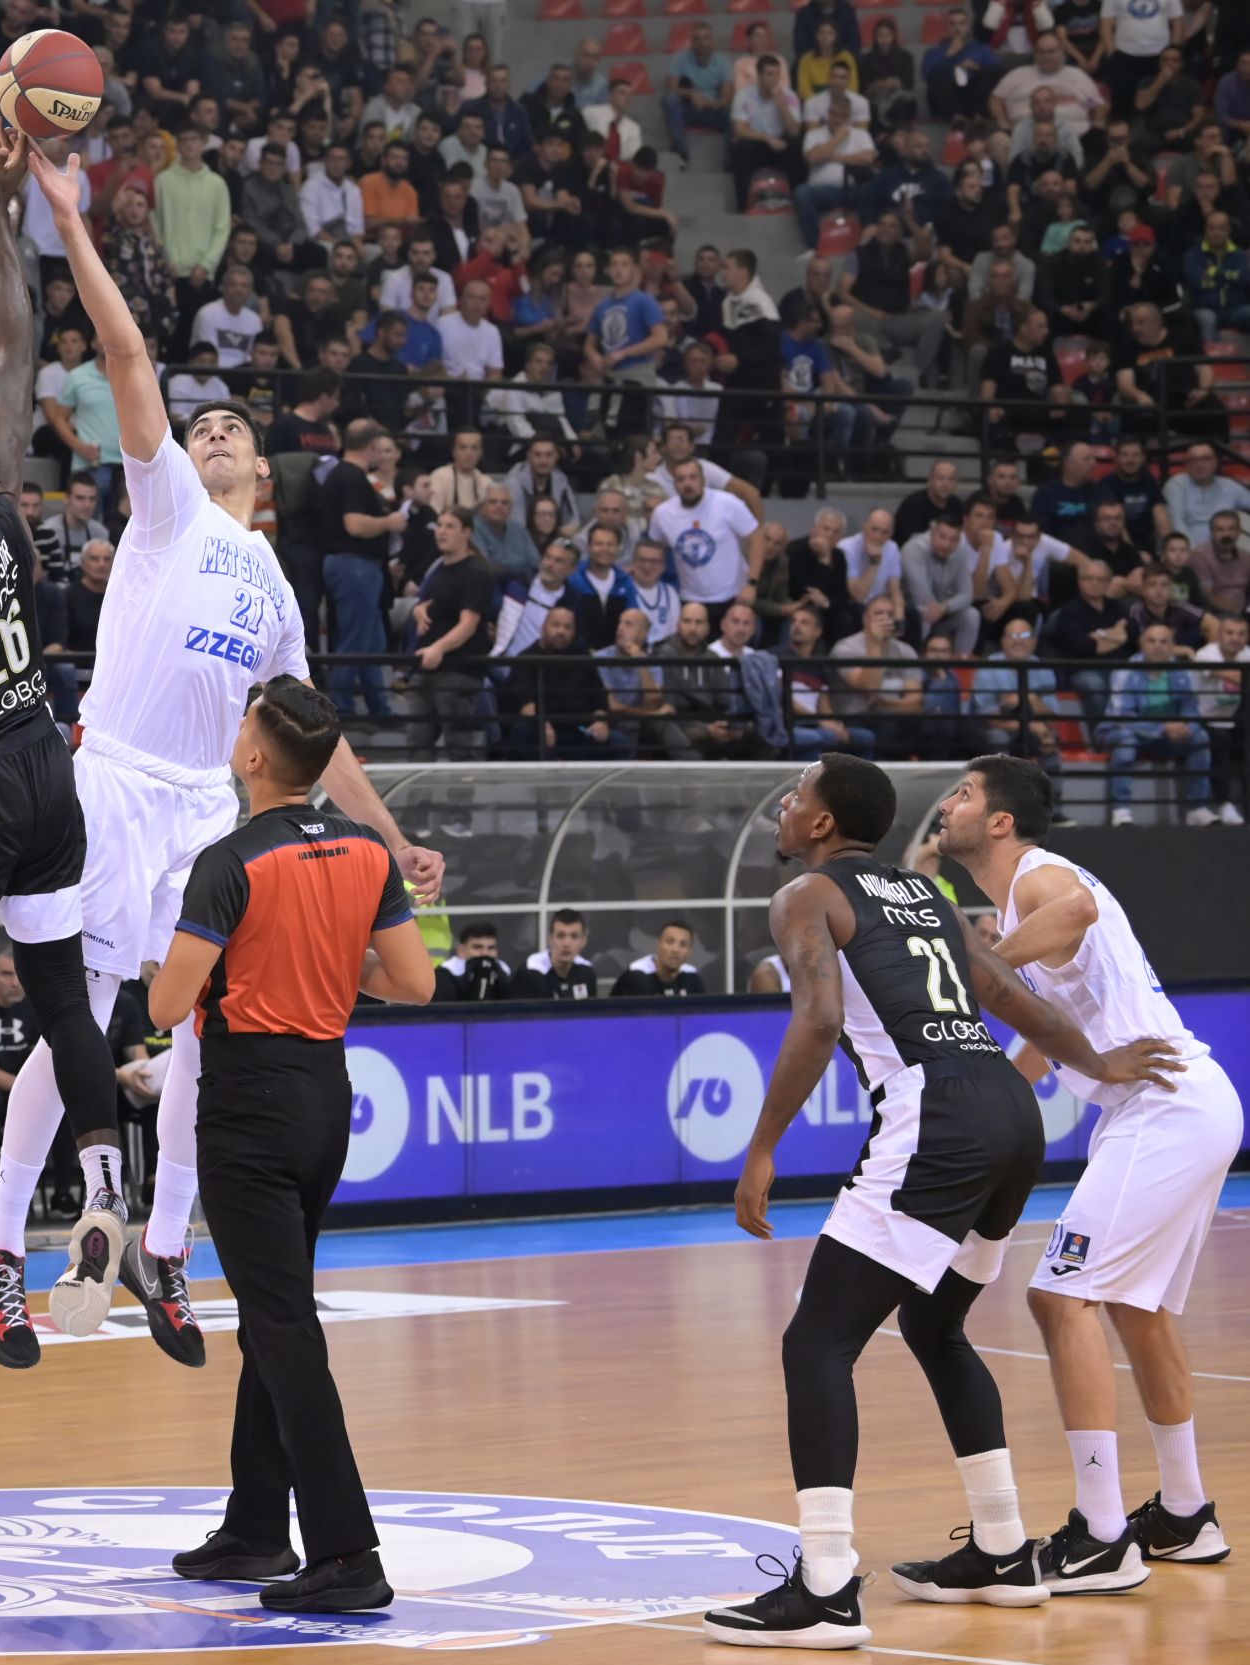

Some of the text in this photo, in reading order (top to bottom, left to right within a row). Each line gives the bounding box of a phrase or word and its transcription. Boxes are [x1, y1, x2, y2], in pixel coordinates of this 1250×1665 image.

[48, 99, 95, 122] SPALD
[199, 536, 239, 578] MZT
[230, 587, 265, 636] 21
[882, 904, 941, 928] mts
[82, 930, 116, 949] DMIRAL
[906, 936, 971, 1015] 21
[426, 1071, 554, 1145] NLB
